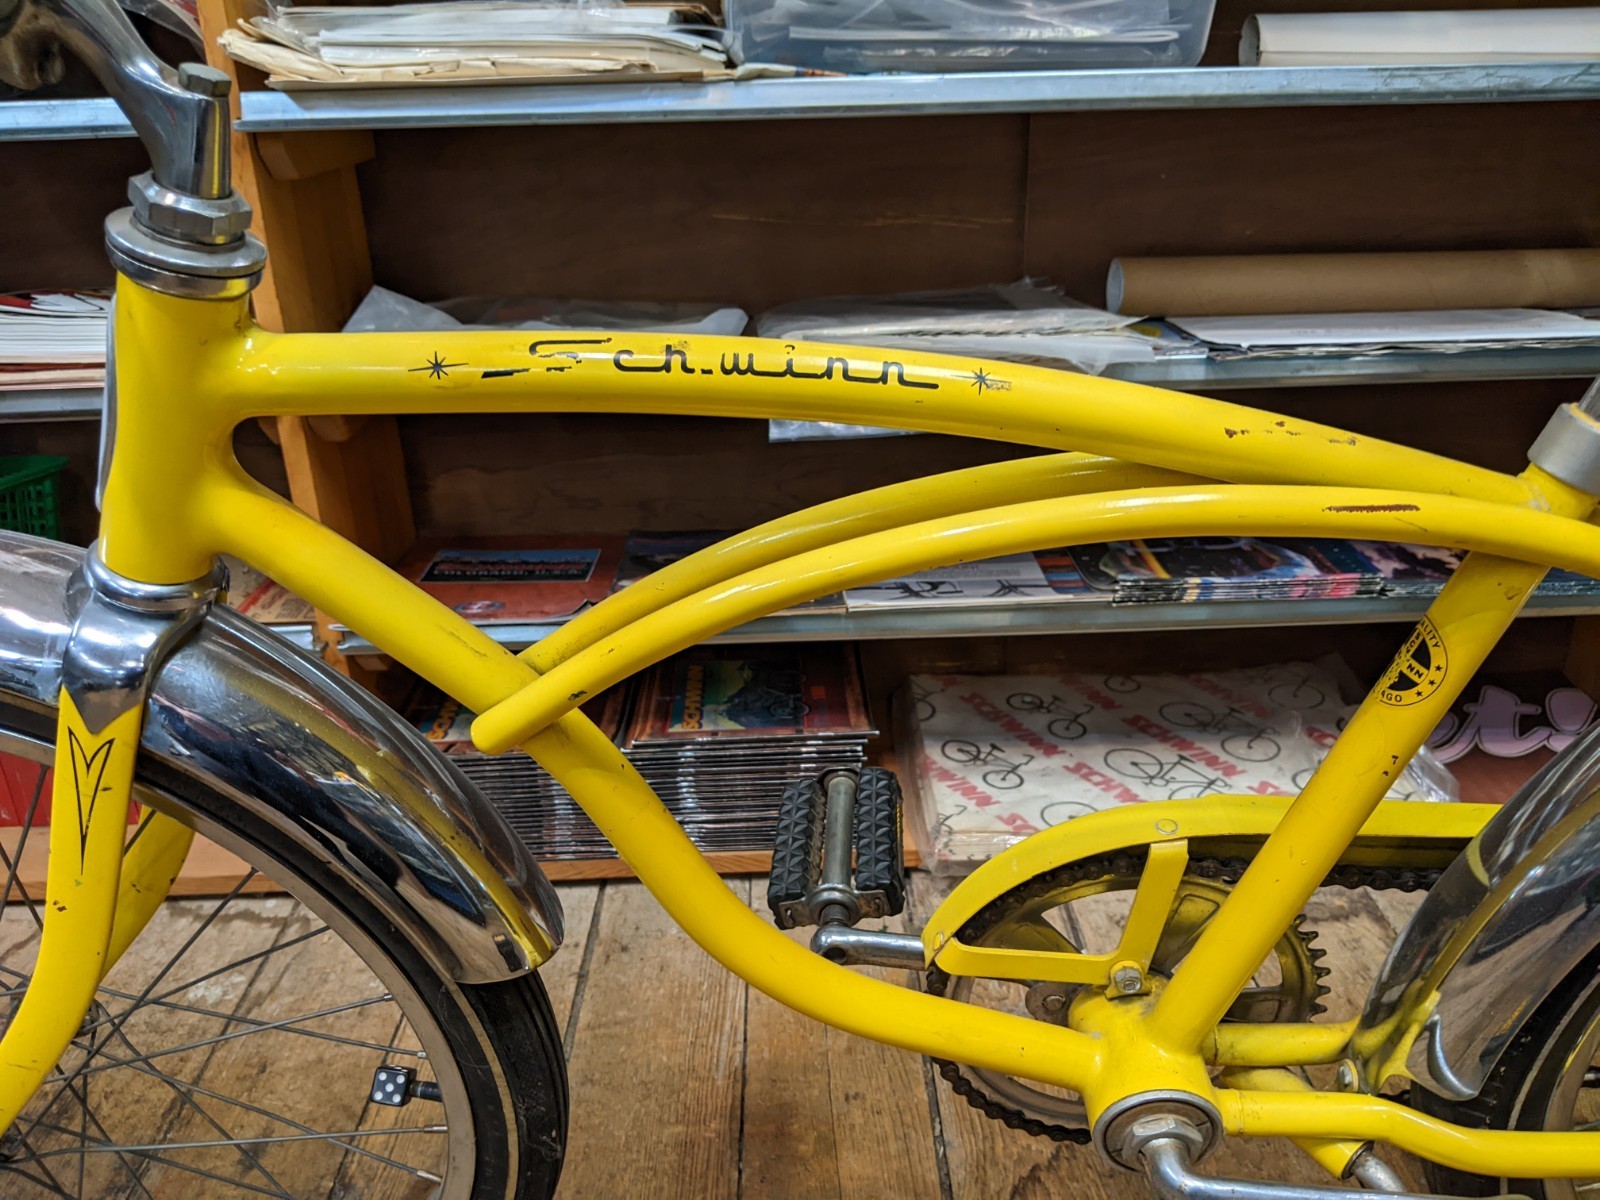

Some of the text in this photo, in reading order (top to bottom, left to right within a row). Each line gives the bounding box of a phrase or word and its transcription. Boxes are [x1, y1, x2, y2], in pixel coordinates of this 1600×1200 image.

[681, 664, 704, 730] SCHWINN
[959, 691, 1068, 757] SCHWINN
[1119, 713, 1249, 779] SCHWINN
[1061, 761, 1151, 803] SCHW
